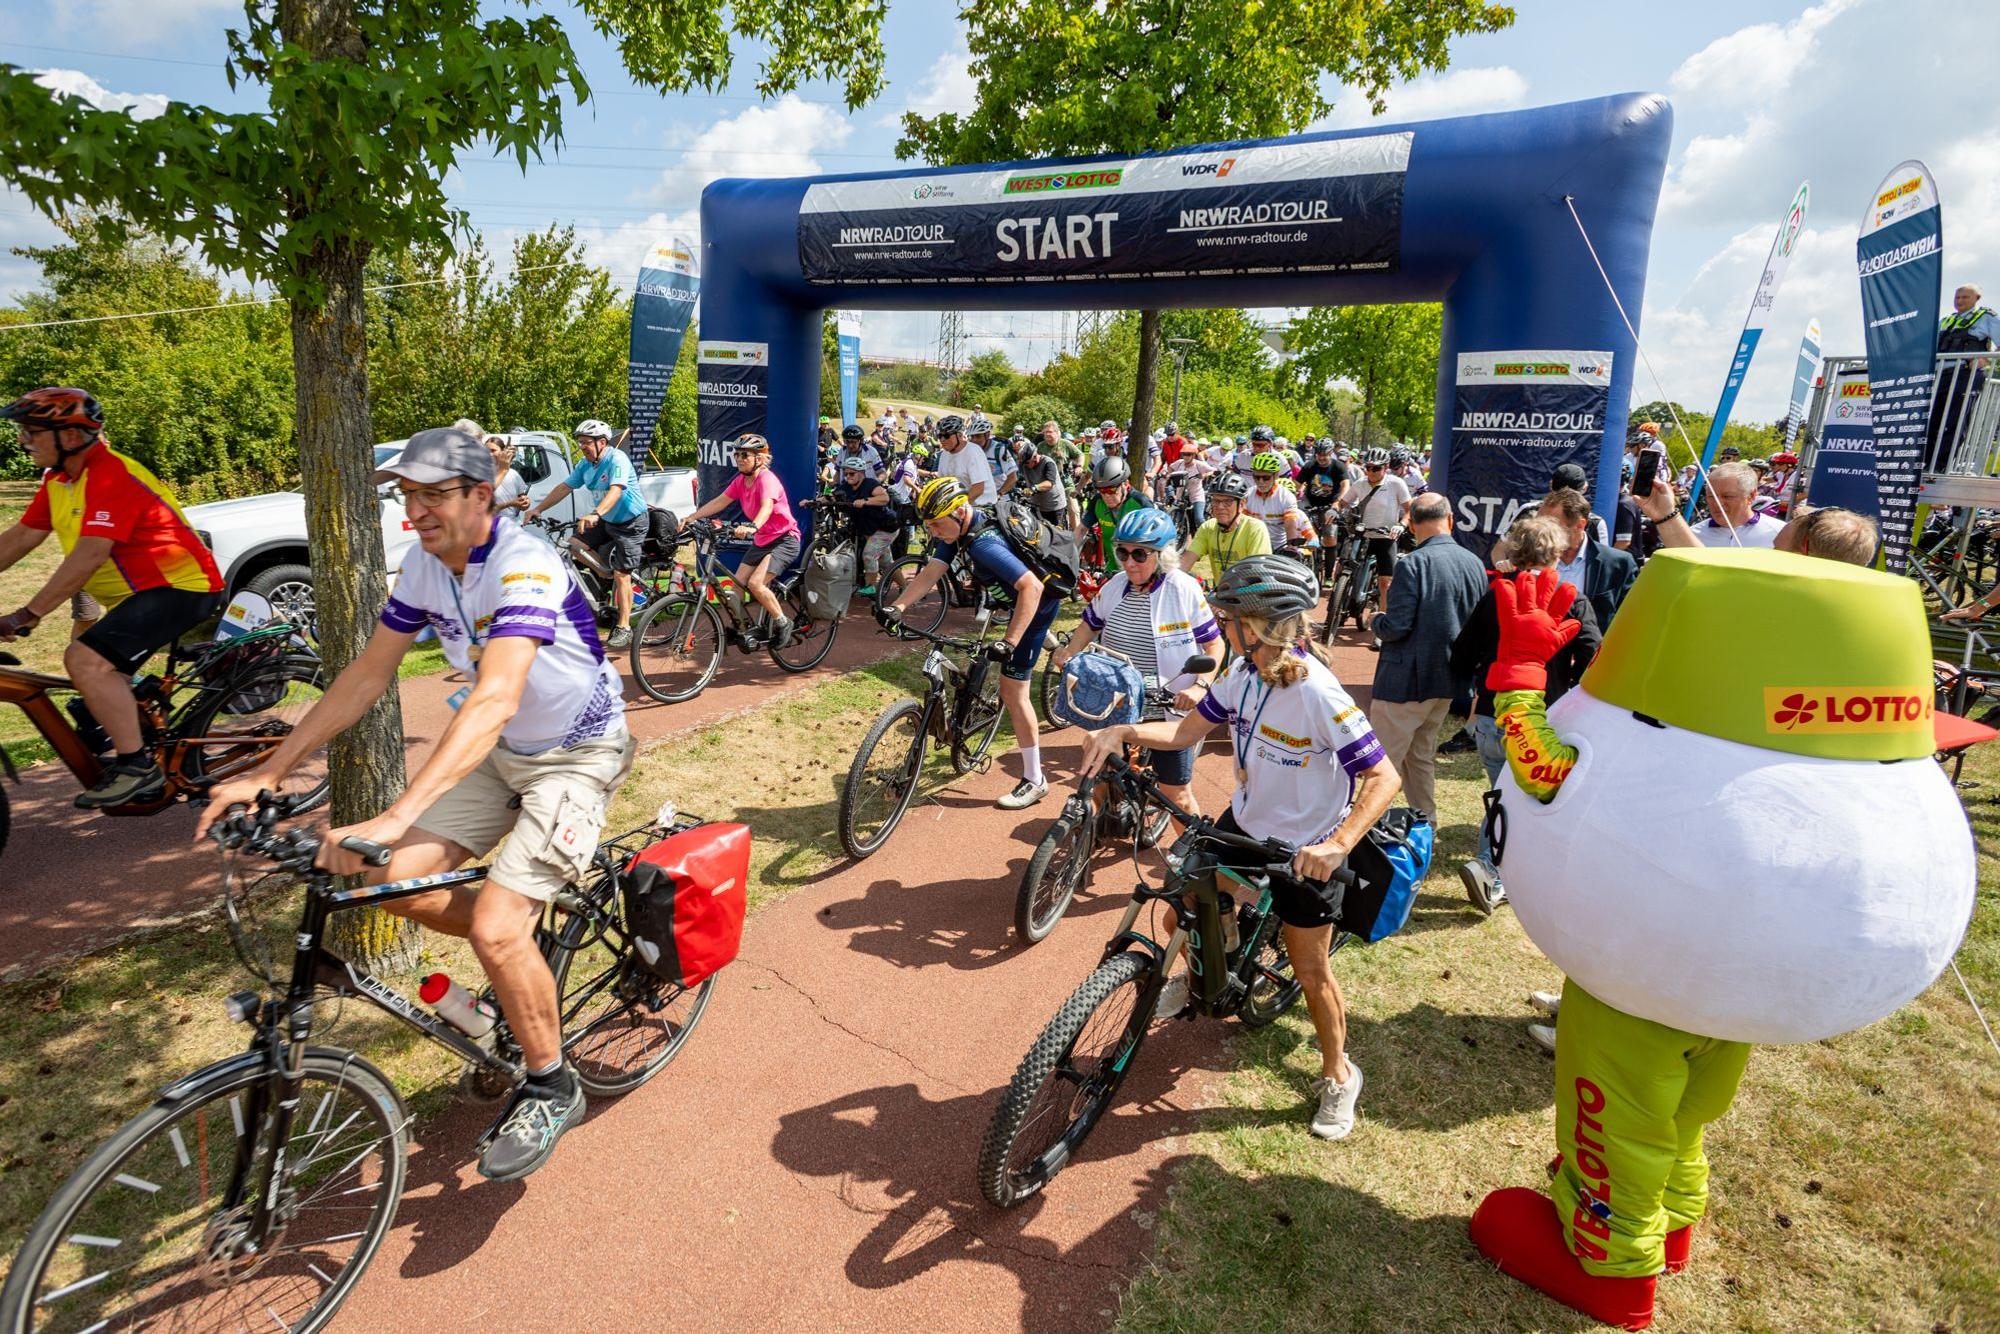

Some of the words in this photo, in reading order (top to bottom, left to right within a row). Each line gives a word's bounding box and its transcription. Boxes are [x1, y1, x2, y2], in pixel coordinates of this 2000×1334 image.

[1182, 164, 1218, 176] WDR
[1009, 177, 1052, 191] WEST
[1066, 173, 1120, 187] LOTTO
[1180, 200, 1328, 228] NRWRADTOUR
[840, 225, 944, 244] NRWRADTOUR
[996, 212, 1118, 262] START
[1197, 231, 1308, 247] www.nrw-radtour.de
[854, 249, 932, 260] www.nrw-radtour.de
[1496, 365, 1524, 374] WEST
[1578, 366, 1597, 374] WDR
[1842, 385, 1871, 396] WES
[1461, 412, 1594, 430] NRWRADTOUR
[1472, 436, 1576, 448] www.nrw-radtour.de
[698, 439, 738, 467] STAR
[1826, 696, 1922, 722] LOTTO
[1575, 1076, 1611, 1204] LOTTO
